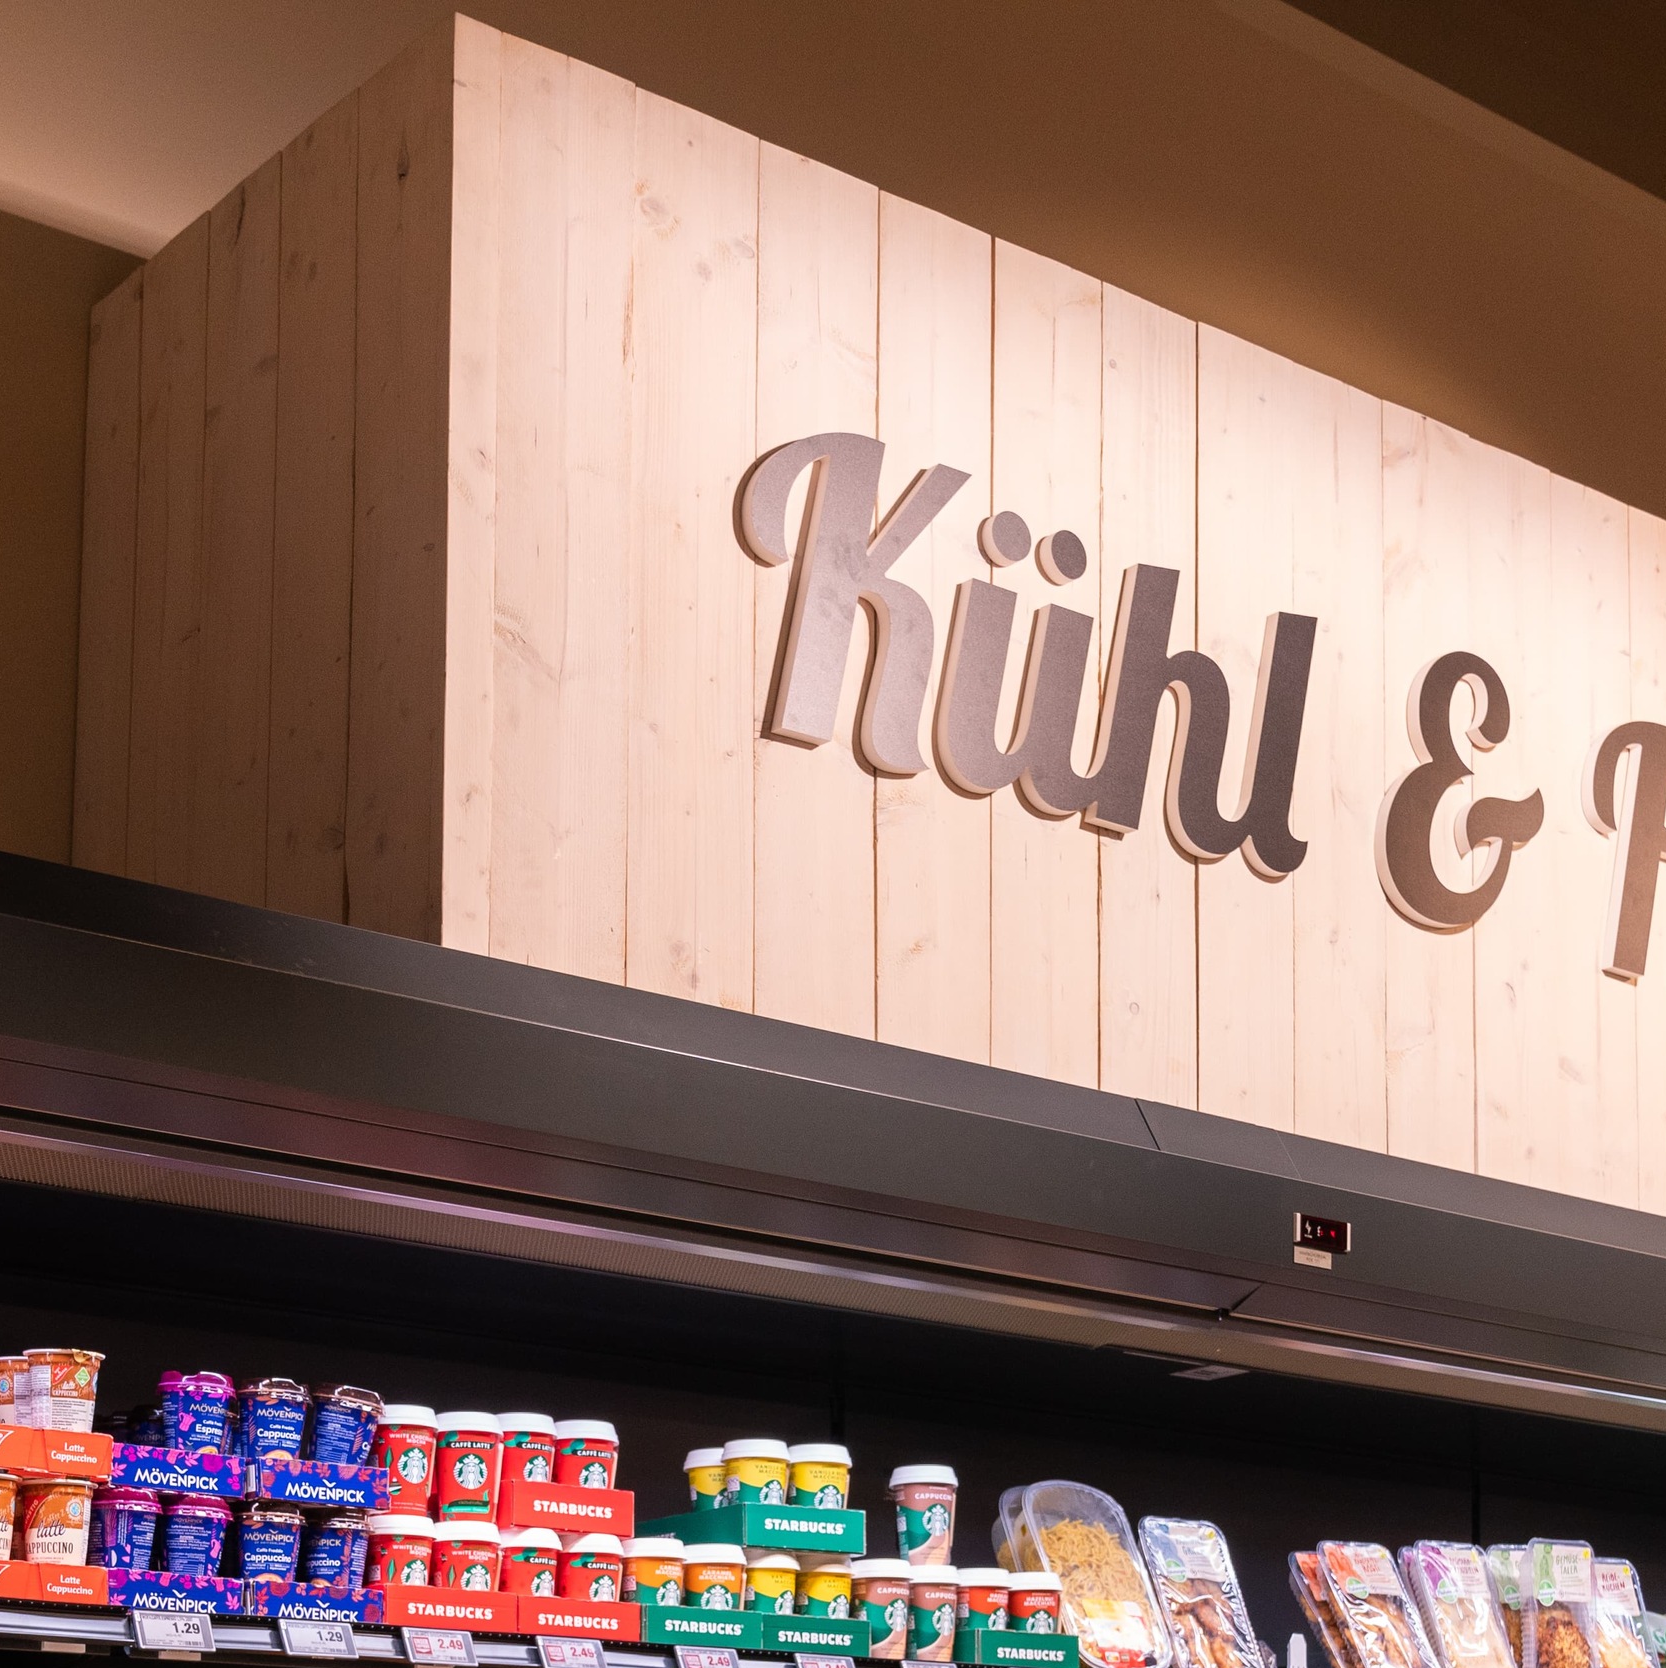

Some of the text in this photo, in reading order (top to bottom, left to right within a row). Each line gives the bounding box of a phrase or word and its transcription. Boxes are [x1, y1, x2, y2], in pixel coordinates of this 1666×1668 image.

[734, 431, 1320, 881] Kühl
[1376, 650, 1545, 932] &
[134, 1467, 219, 1491] MÖVENPICK
[285, 1480, 365, 1503] MÖVENPICK
[533, 1500, 613, 1519] STARBUCKS
[764, 1518, 843, 1535] STARBUCKS
[243, 1530, 295, 1543] MÖVENPICK
[244, 1551, 293, 1565] Cappuccino
[408, 1602, 493, 1620] STARBUCKS
[172, 1621, 201, 1635] 1.29
